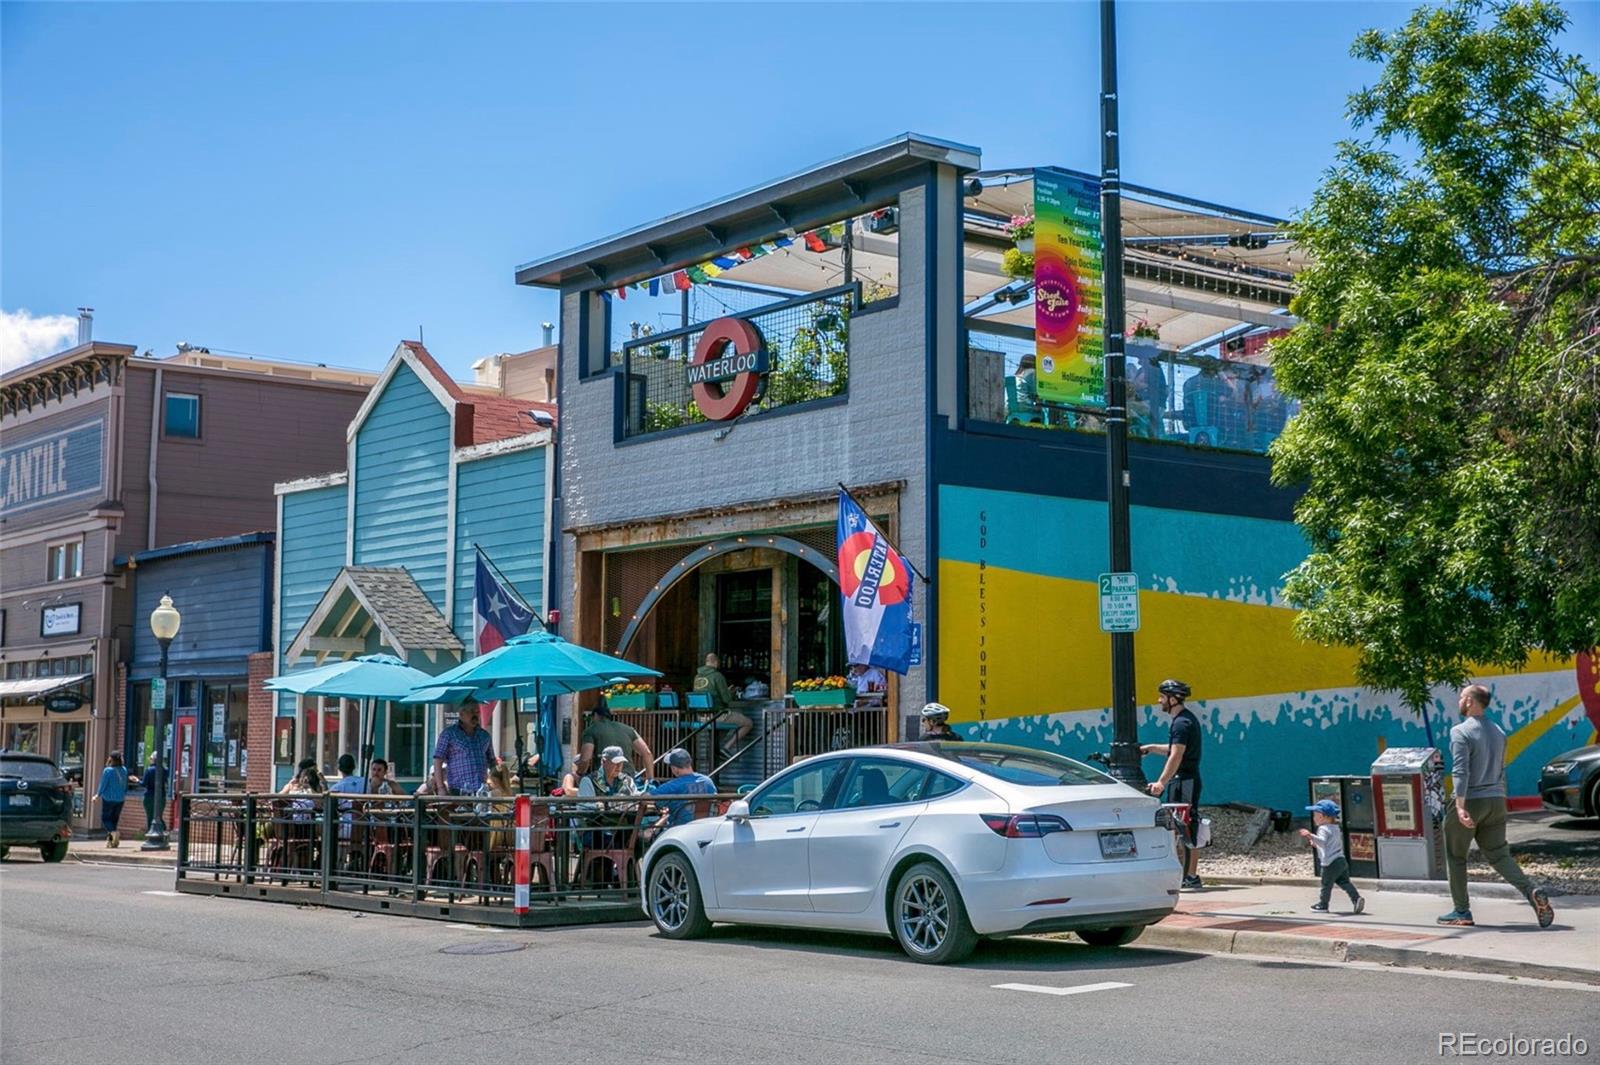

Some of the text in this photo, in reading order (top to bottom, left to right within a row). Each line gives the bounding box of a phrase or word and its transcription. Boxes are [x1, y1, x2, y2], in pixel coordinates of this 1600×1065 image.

[1074, 207, 1100, 219] June 17
[1074, 227, 1091, 238] June
[1057, 234, 1068, 244] Ten
[1068, 236, 1085, 249] Years
[1037, 287, 1061, 302] Street
[1077, 304, 1093, 316] July
[1077, 324, 1093, 336] July
[688, 353, 756, 383] WATERLOO
[979, 510, 987, 549] GOD
[1102, 578, 1110, 593] 2
[979, 559, 987, 628] BLESS
[979, 635, 987, 720] JOHNNY
